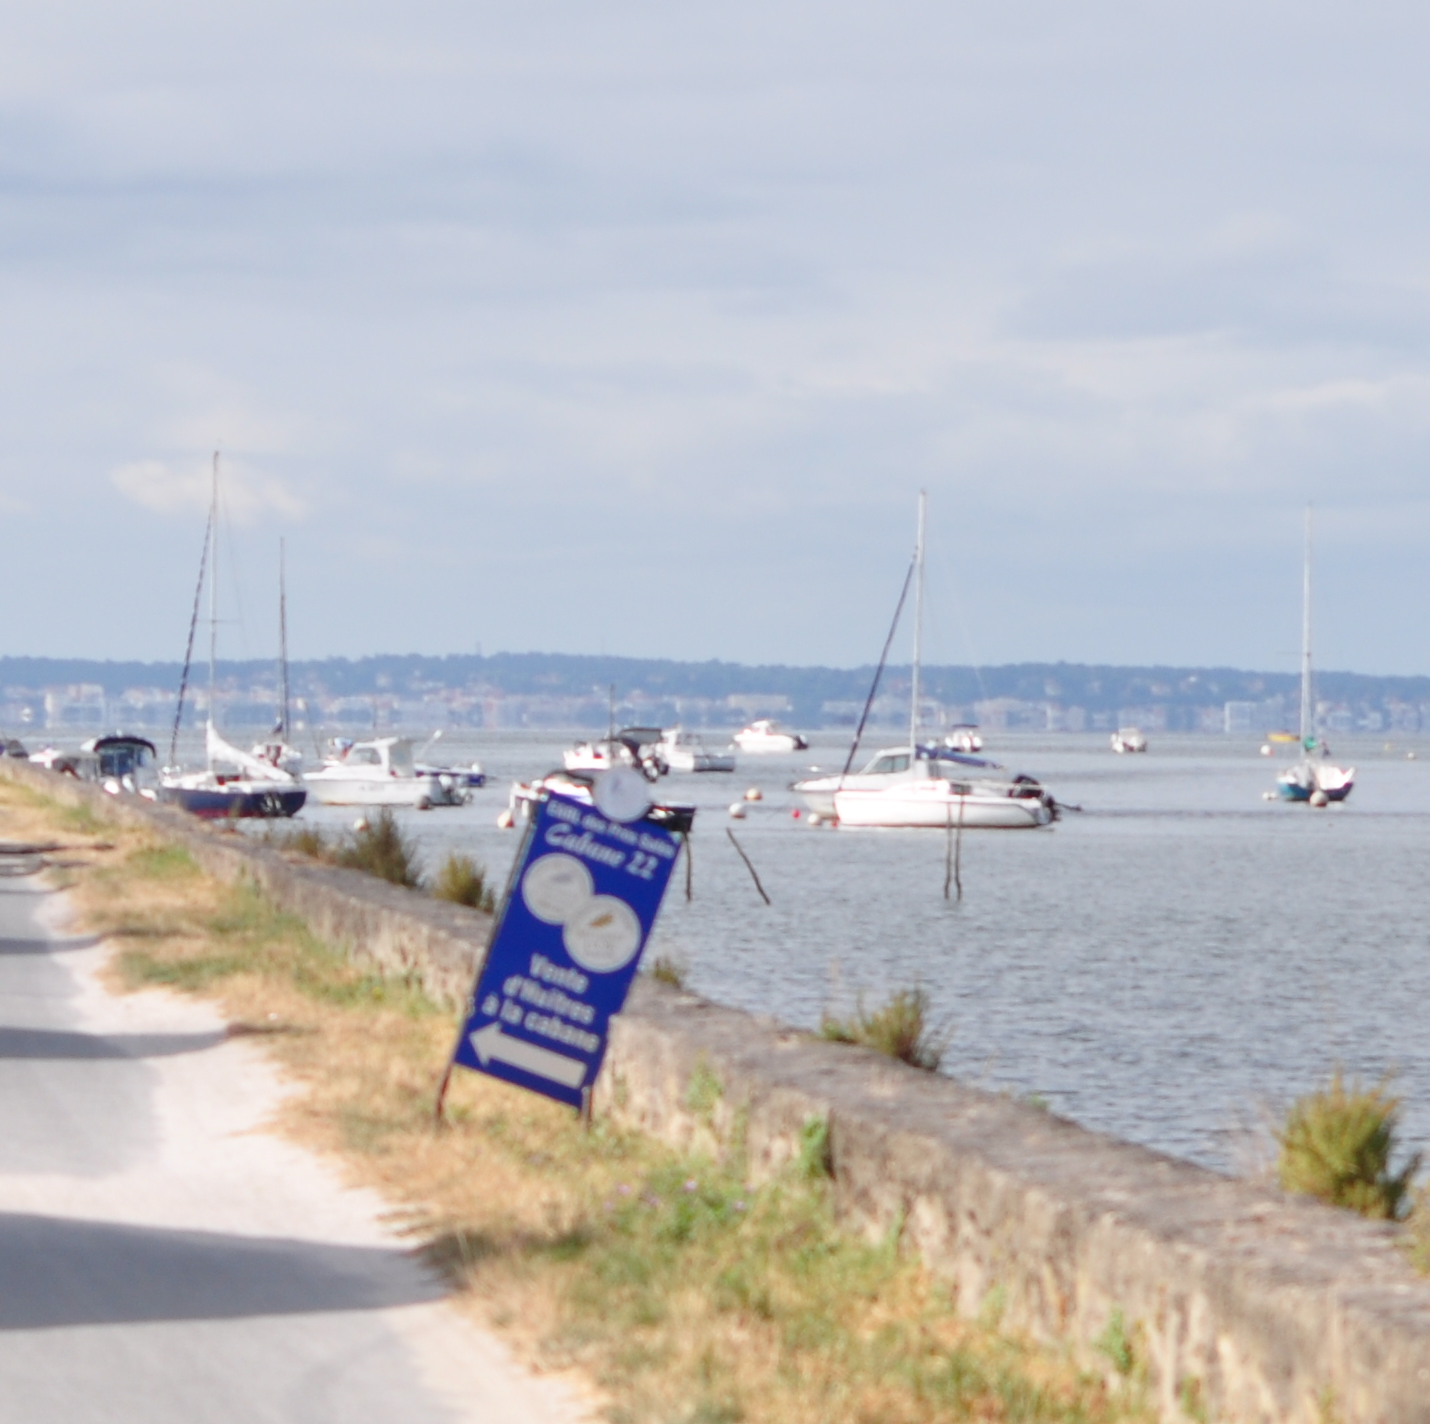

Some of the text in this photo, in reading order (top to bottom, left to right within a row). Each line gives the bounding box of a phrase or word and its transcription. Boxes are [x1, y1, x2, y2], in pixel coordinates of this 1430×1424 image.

[545, 823, 659, 880] Cabane 22
[529, 952, 589, 995] Vente
[499, 998, 523, 1025] la
[524, 1011, 600, 1054] cabane
